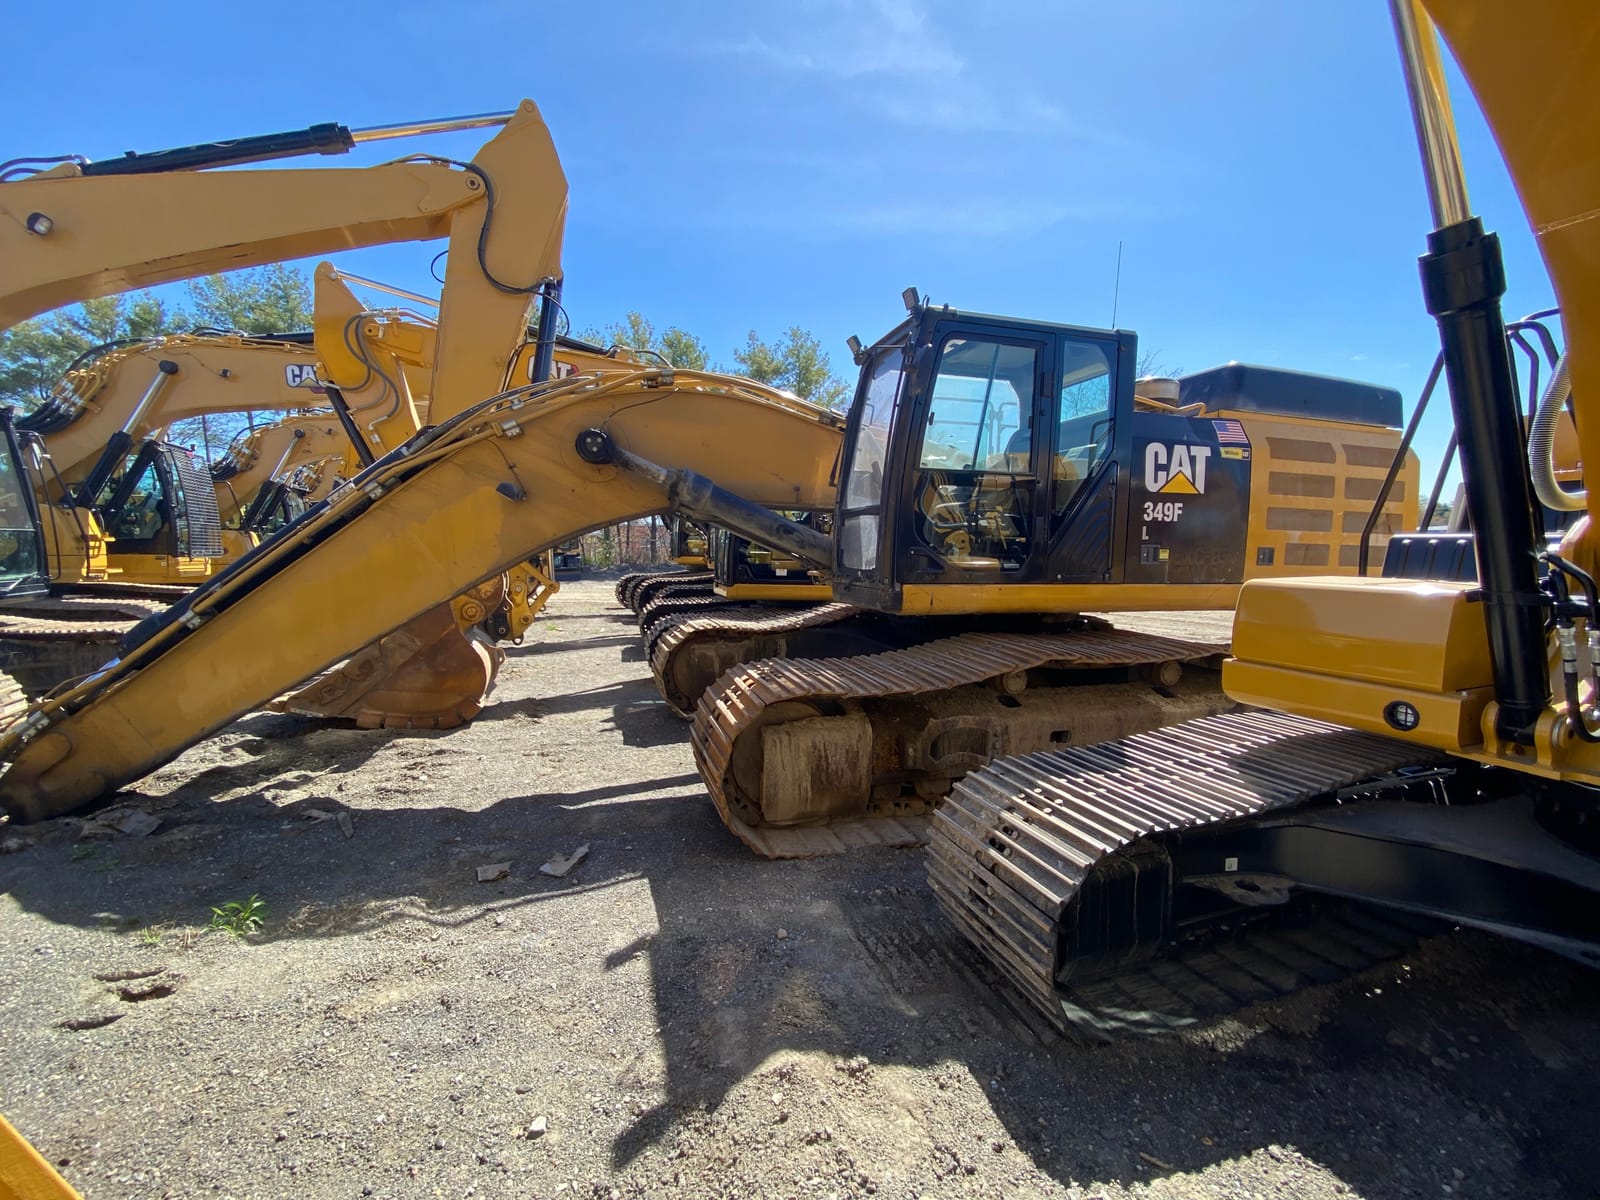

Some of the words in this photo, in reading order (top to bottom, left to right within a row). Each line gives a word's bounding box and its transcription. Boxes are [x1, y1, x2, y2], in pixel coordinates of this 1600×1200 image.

[285, 364, 319, 387] CA
[1145, 442, 1211, 494] CAT
[1143, 502, 1183, 521] 349F
[1142, 525, 1149, 540] L
